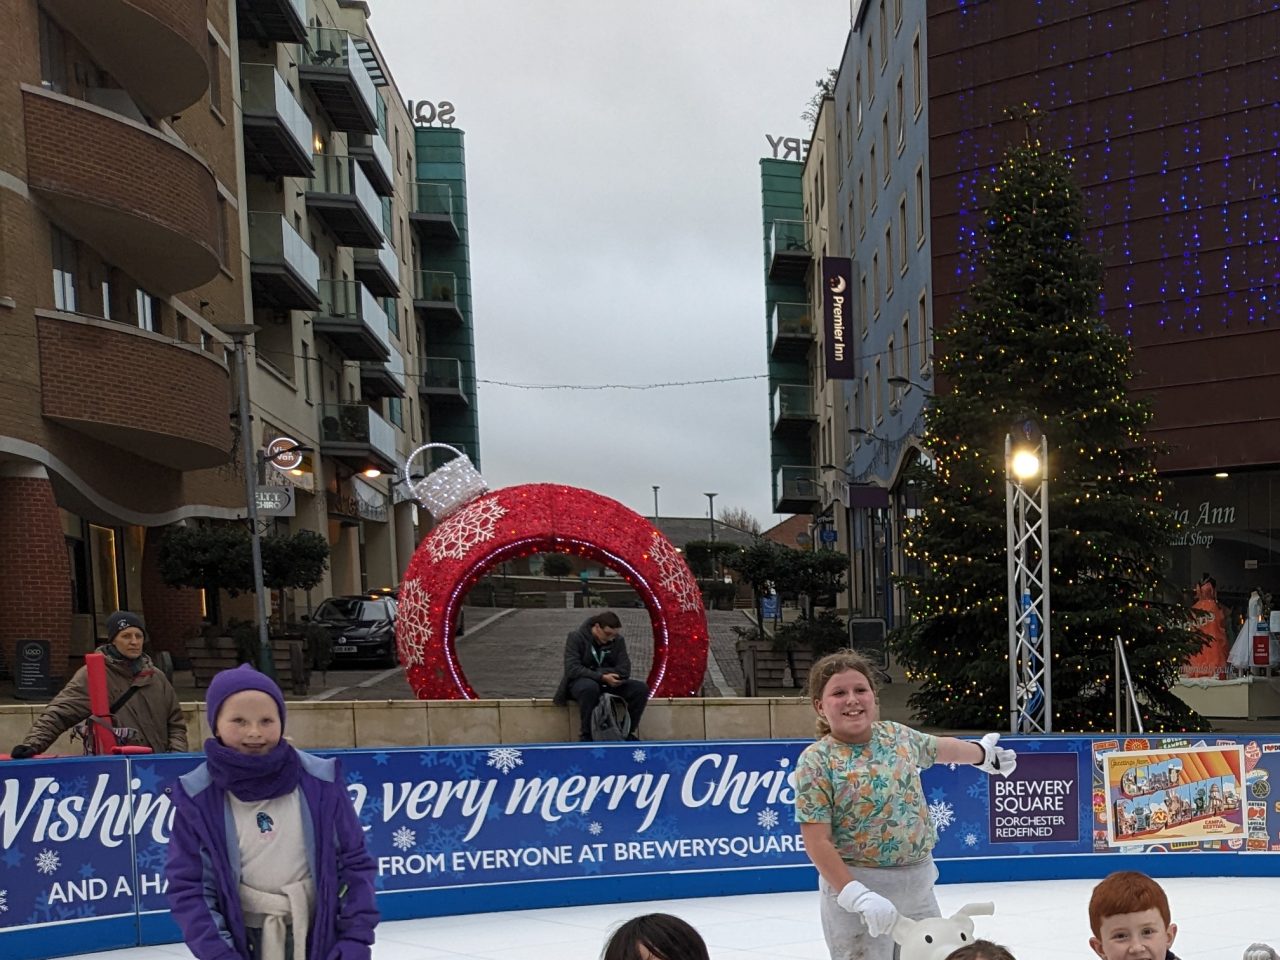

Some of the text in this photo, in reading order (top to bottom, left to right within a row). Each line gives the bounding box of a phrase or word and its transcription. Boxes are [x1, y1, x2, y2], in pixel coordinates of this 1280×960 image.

[832, 296, 846, 361] Premier Inn
[1196, 501, 1236, 526] Ann
[1189, 531, 1214, 549] Shop
[995, 780, 1073, 796] BREWERY
[0, 773, 178, 849] Wishin
[382, 778, 500, 842] very
[504, 771, 671, 832] merry
[996, 797, 1064, 812] SQUARE
[996, 816, 1066, 826] DORCHESTER
[996, 826, 1053, 837] REDEFINED
[48, 878, 108, 905] AND
[112, 876, 133, 898] A
[379, 853, 445, 876] FROM
[452, 847, 573, 872] EVERYONE
[578, 844, 604, 863] AT
